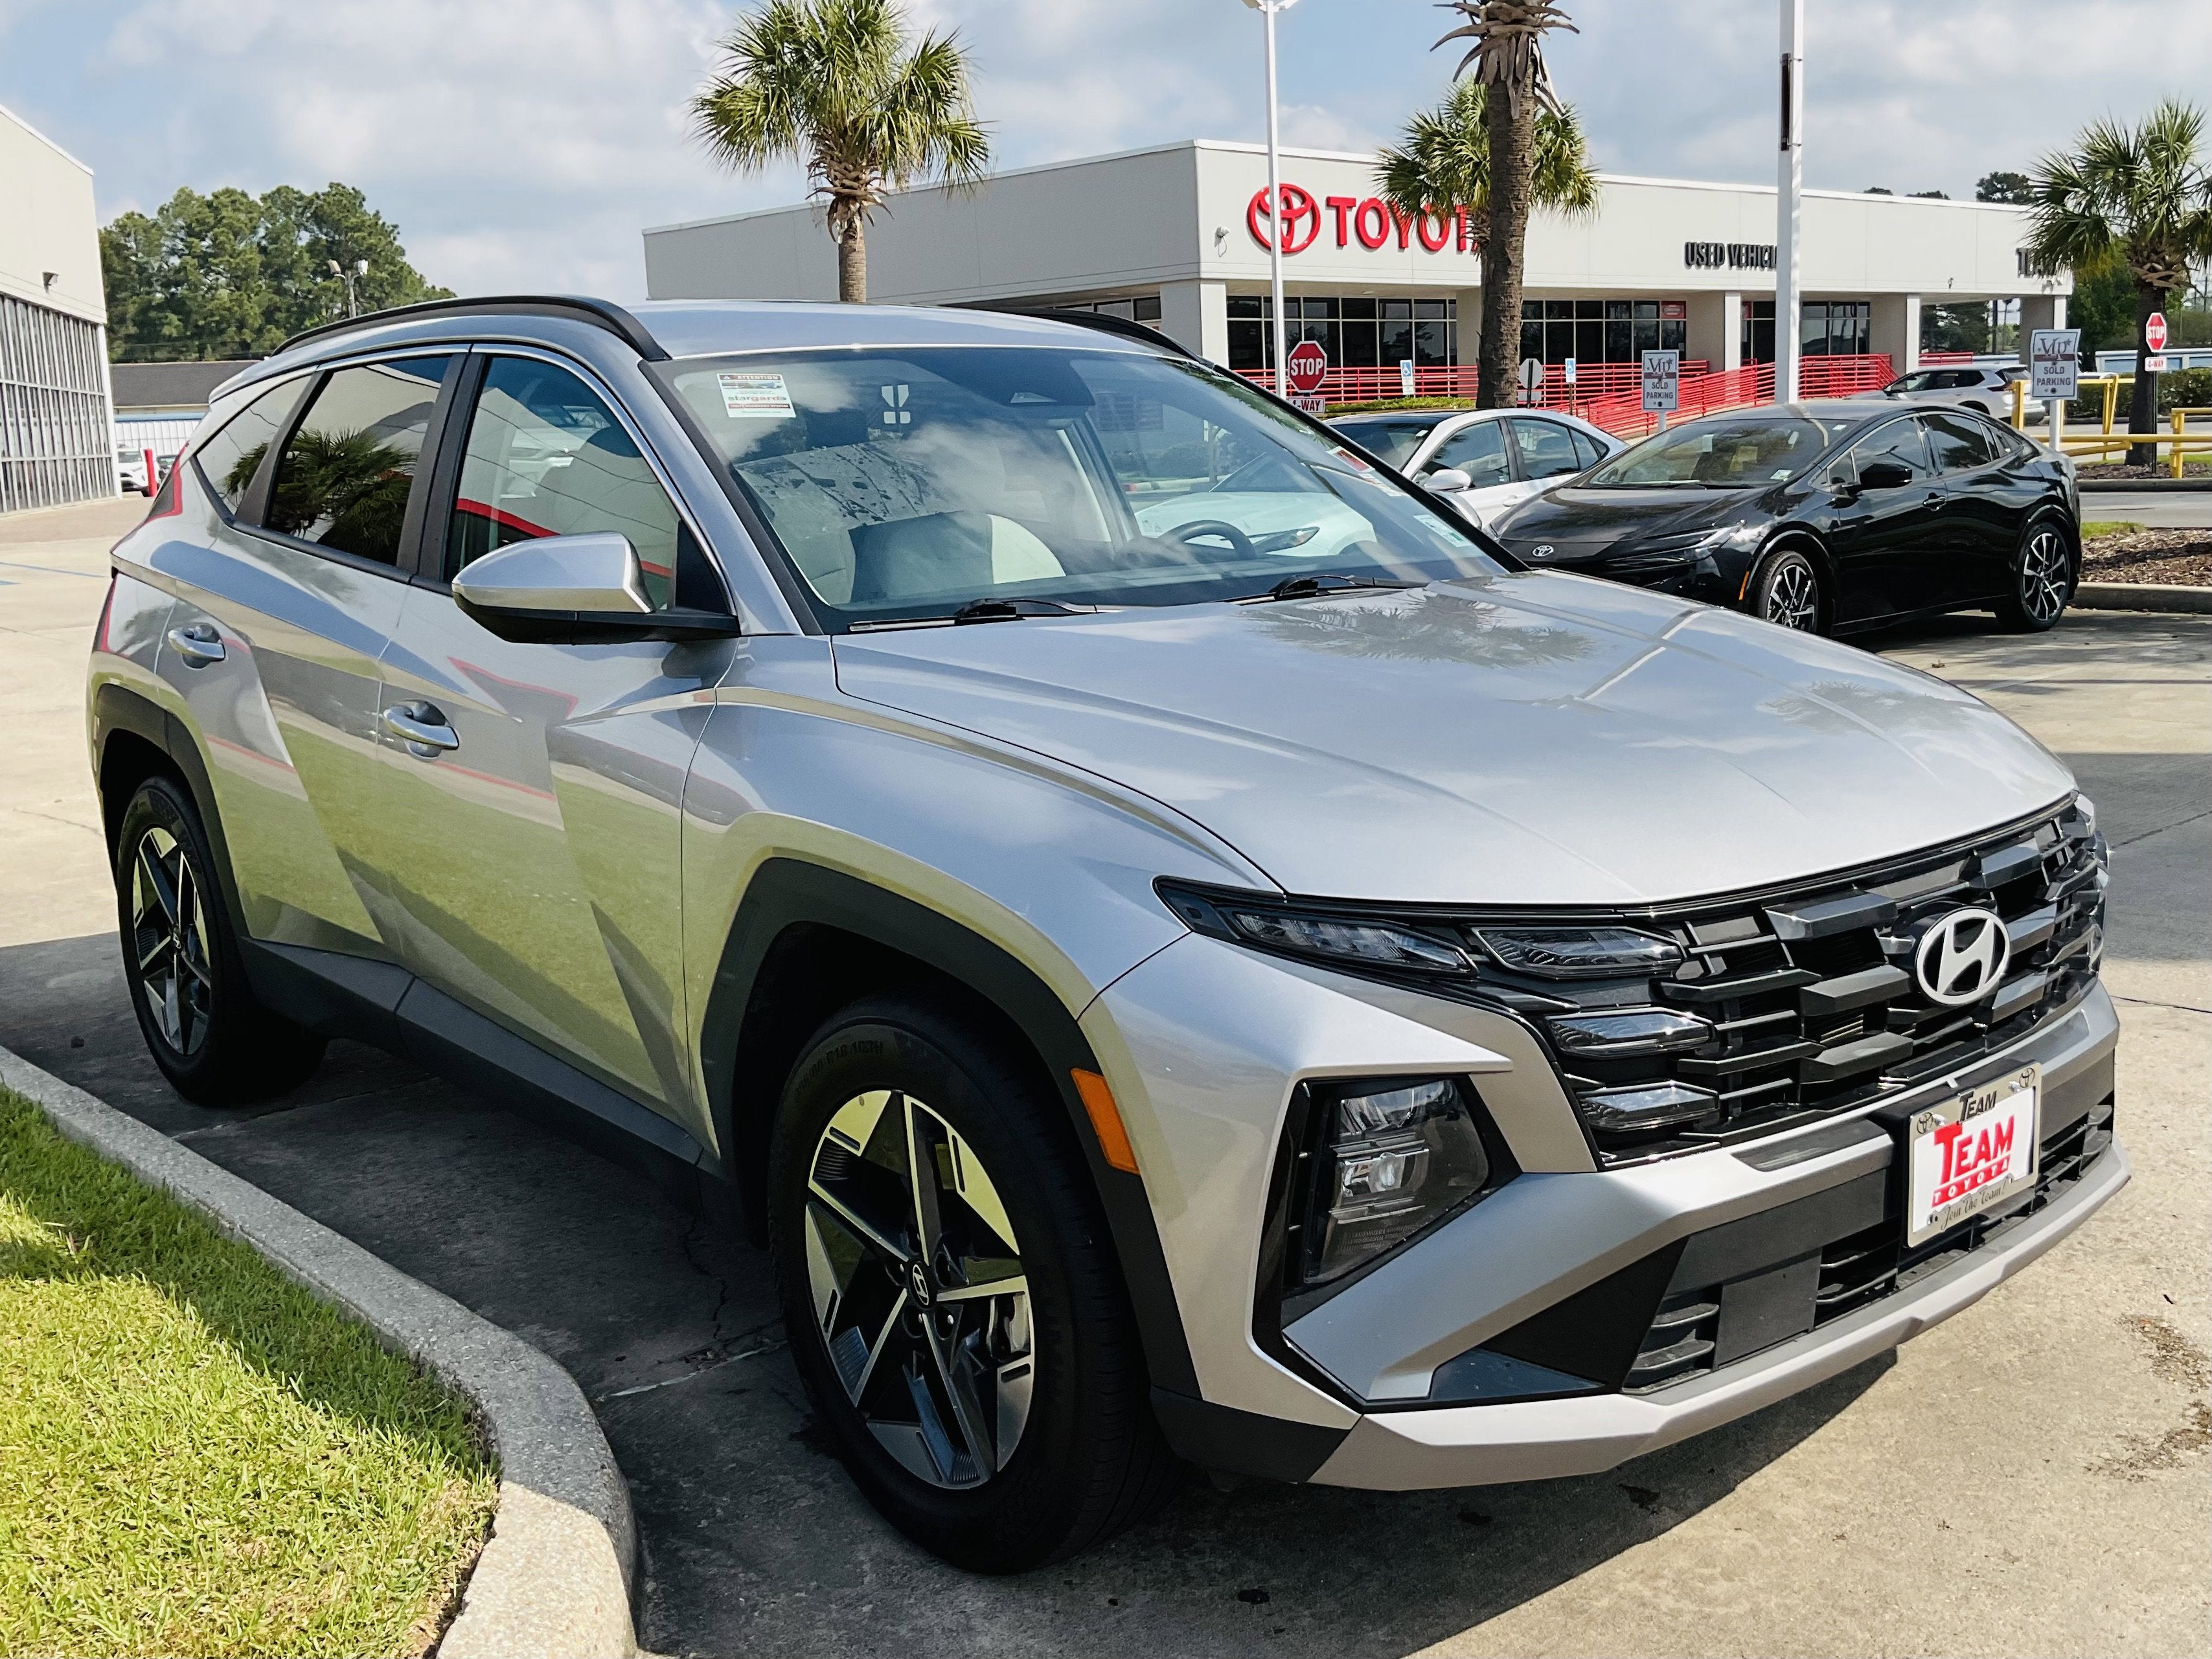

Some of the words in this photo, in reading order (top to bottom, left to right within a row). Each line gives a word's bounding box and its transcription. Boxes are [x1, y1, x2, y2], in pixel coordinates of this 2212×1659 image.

[1327, 196, 1478, 251] TOYOT
[1685, 242, 1725, 267] USED
[1727, 243, 1777, 269] VEHICL
[2148, 326, 2164, 339] STOP
[1290, 358, 1324, 376] STOP
[2044, 366, 2065, 374] SOLD
[2148, 360, 2164, 368] 4-WAY
[2036, 377, 2071, 386] PARKING
[1959, 1090, 1997, 1122] TEAM
[1933, 1115, 2015, 1185] TEAM
[1933, 1158, 2009, 1204] TOYOTA
[1962, 1195, 1978, 1213] The
